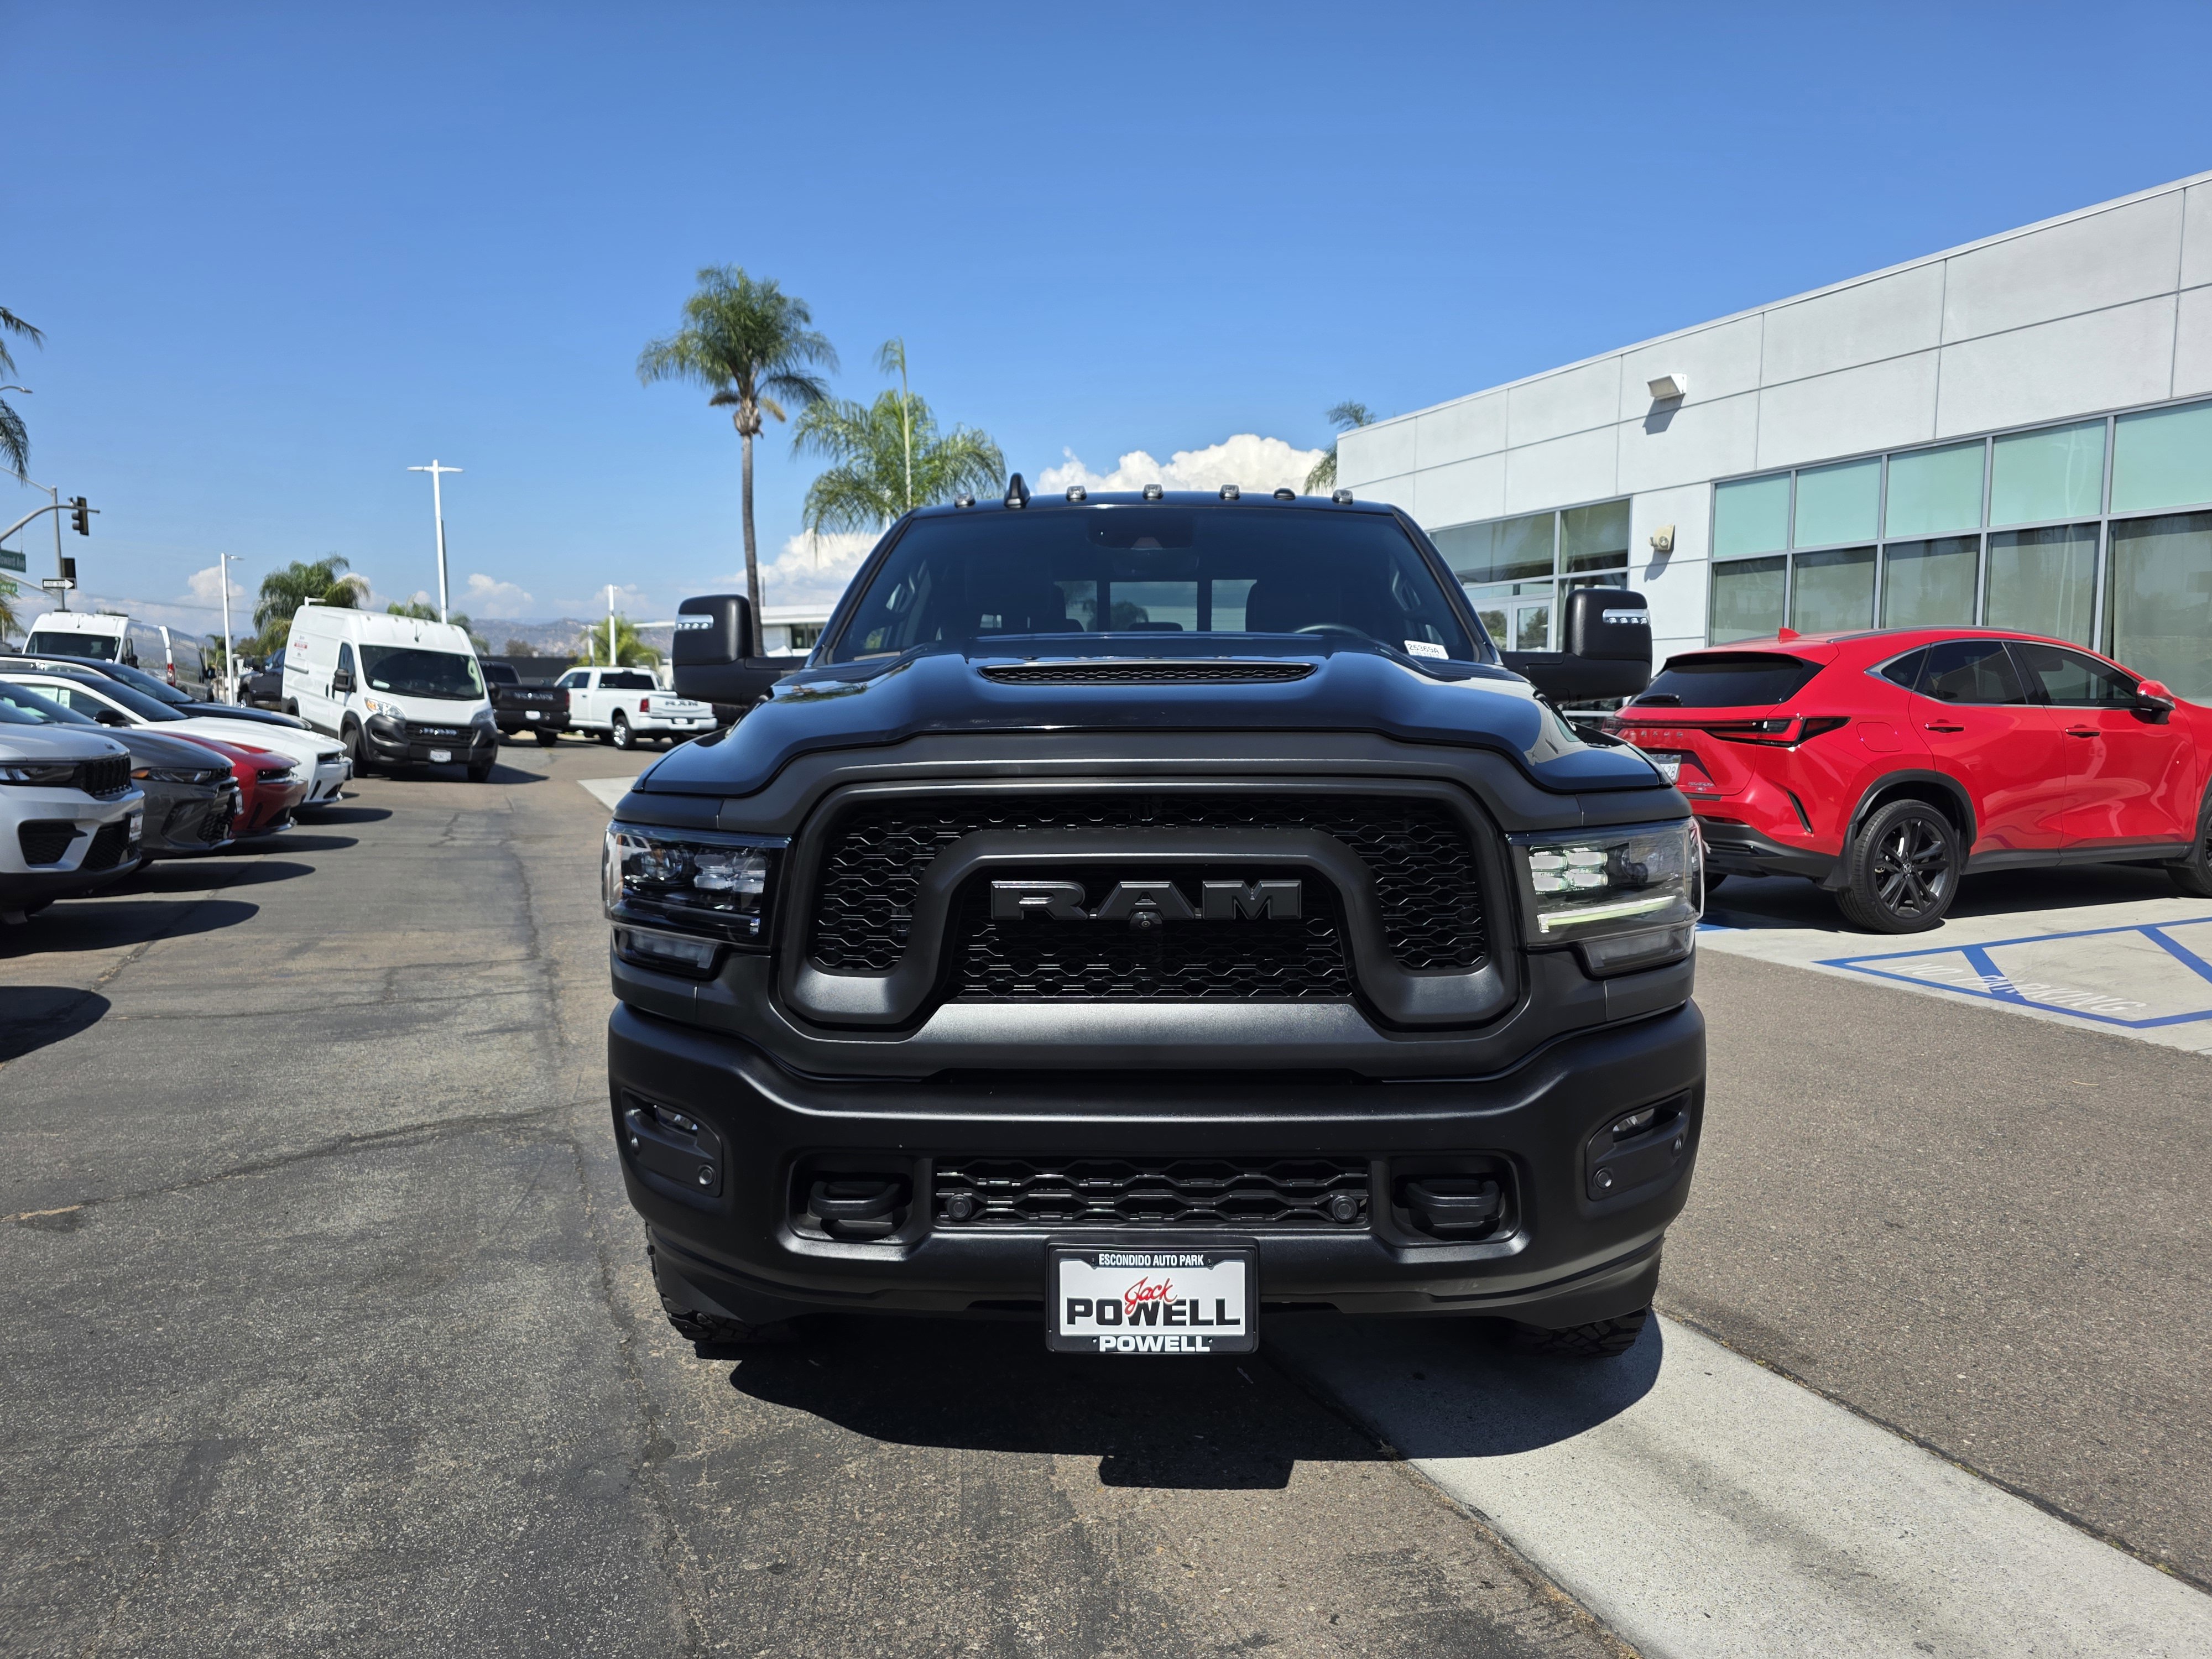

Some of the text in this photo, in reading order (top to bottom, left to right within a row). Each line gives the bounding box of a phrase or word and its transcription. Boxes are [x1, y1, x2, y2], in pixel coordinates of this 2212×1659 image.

[991, 880, 1302, 920] RAM
[1099, 1254, 1204, 1266] ESCONDIDO AUTO PARK
[1124, 1276, 1178, 1315] Jack
[1067, 1297, 1240, 1326] POWELL
[1099, 1336, 1211, 1352] POWELL
